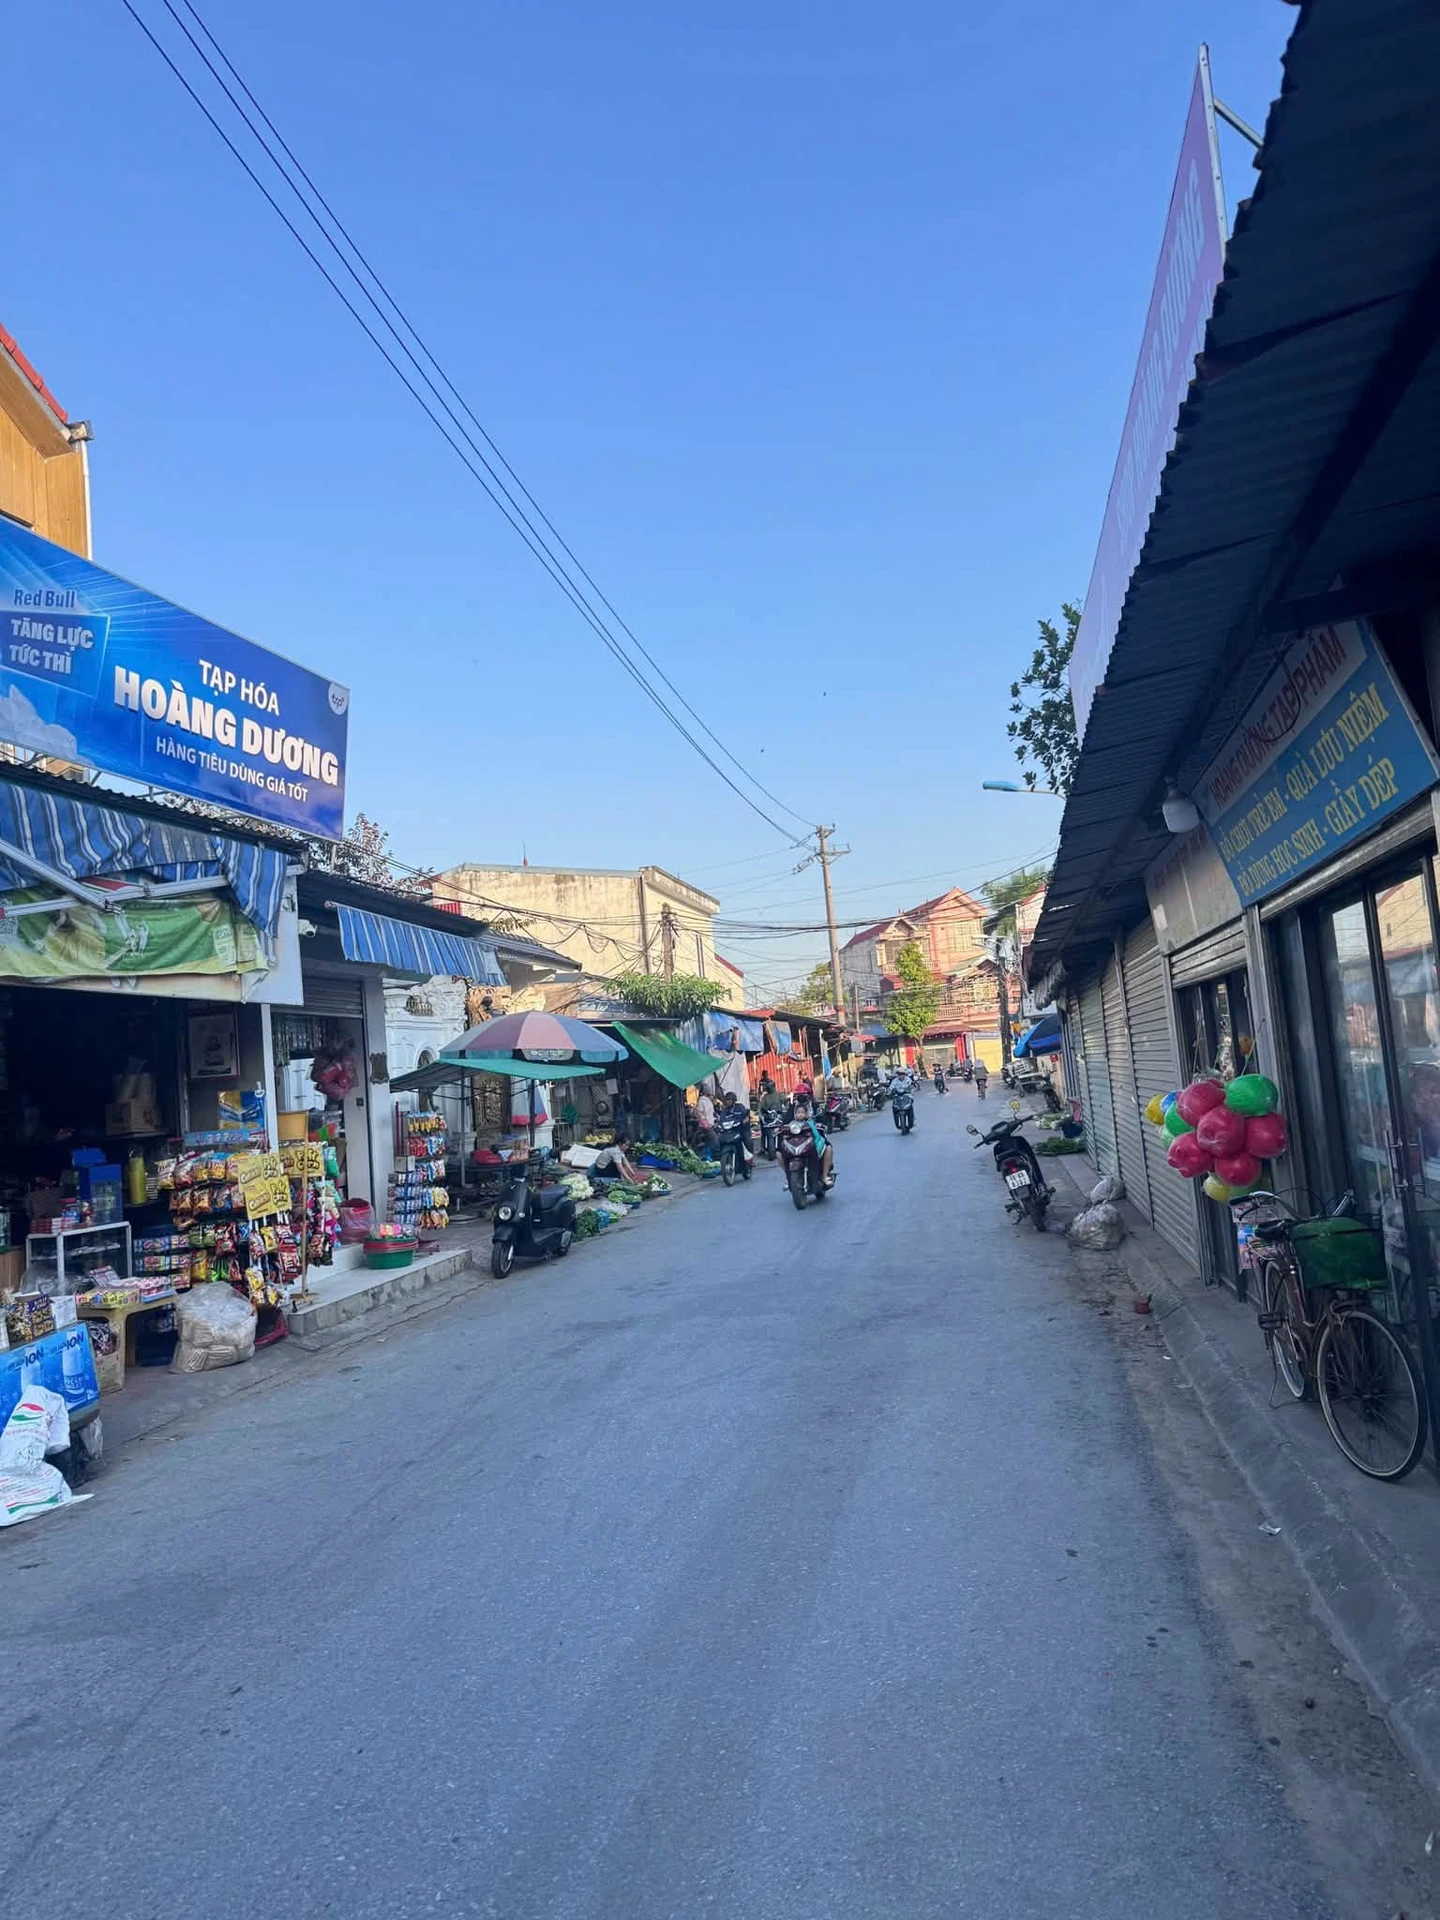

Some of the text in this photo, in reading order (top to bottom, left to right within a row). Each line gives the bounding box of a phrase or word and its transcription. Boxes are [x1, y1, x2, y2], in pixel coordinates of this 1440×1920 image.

[13, 588, 76, 609] Red Bull
[11, 617, 95, 651] TĂNG LỰC
[9, 644, 73, 675] TỨC THÌ
[199, 659, 280, 717] TẠP HÓA
[114, 665, 340, 787] HOÀNG DƯƠNG
[156, 736, 309, 803] HÀNG TIÊU DÙNG GIÁ TỐT
[1264, 787, 1288, 822] EM
[1286, 751, 1318, 802] QUÀ
[1337, 682, 1390, 752] NIỆM
[1270, 840, 1298, 876] HỌC
[1291, 818, 1326, 859] SINH
[1357, 754, 1399, 811] DÉP
[25, 1347, 44, 1367] ION
[67, 1332, 84, 1350] ION
